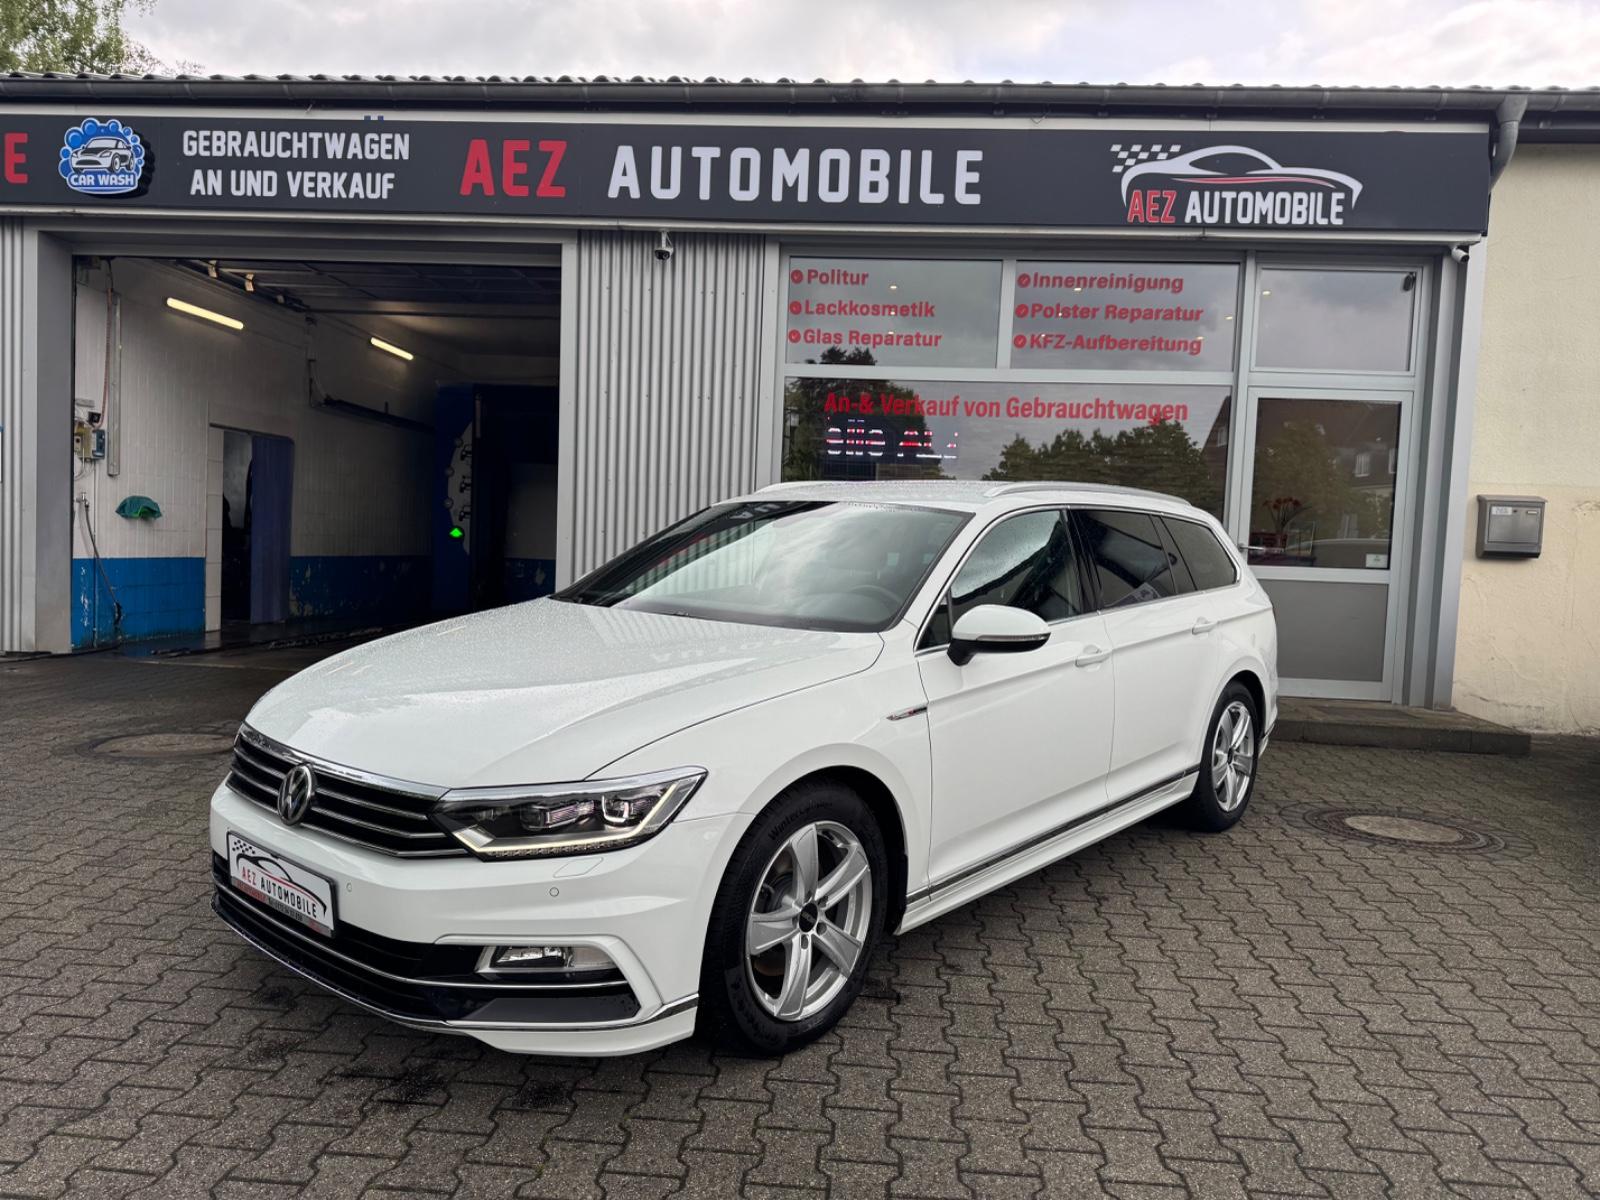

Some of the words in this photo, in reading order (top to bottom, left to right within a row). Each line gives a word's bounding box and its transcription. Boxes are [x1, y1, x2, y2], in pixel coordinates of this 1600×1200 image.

[182, 130, 410, 161] GEBRAUCHTWAGEN
[70, 174, 95, 186] CAR
[97, 174, 134, 187] WASH
[460, 138, 568, 198] AEZ
[607, 144, 984, 205] AUTOMOBILE
[190, 169, 222, 197] AN
[230, 170, 278, 198] UND
[287, 171, 395, 200] VERKAUF
[1127, 189, 1177, 223] AEZ
[1184, 190, 1346, 226] AUTOMOBILE
[806, 268, 869, 287] Politur
[1032, 272, 1184, 294] Innenreinigung
[804, 300, 935, 319] Lackkosmetik
[1030, 302, 1099, 321] Polster
[1104, 304, 1204, 323] Reparatur
[803, 329, 843, 346] Glas
[848, 330, 943, 348] Reparatur
[1029, 333, 1202, 356] KFZ-Aufbereitung
[880, 393, 960, 418] Verkauf
[963, 400, 1000, 418] von
[1005, 396, 1189, 428] Gebrauchtwagen
[241, 866, 257, 886] AEZ
[260, 876, 317, 919] AUTOMOBILE
